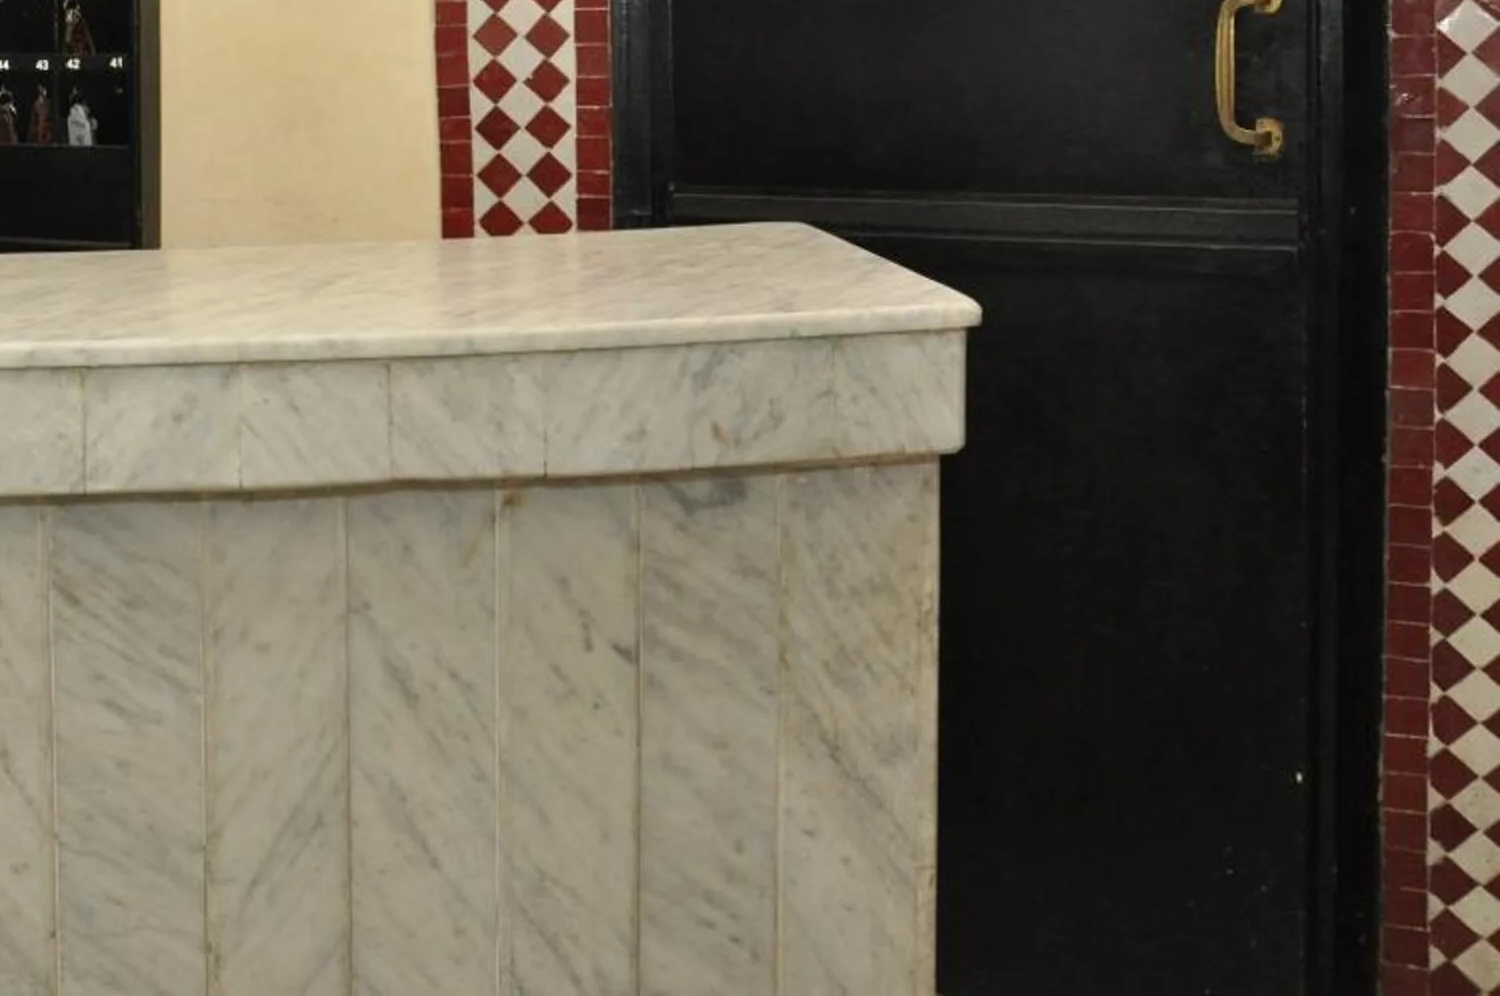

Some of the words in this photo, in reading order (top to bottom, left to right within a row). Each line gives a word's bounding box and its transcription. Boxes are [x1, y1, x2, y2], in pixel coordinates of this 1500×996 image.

[35, 59, 49, 71] 43
[66, 58, 81, 70] 42
[109, 57, 123, 68] 41
